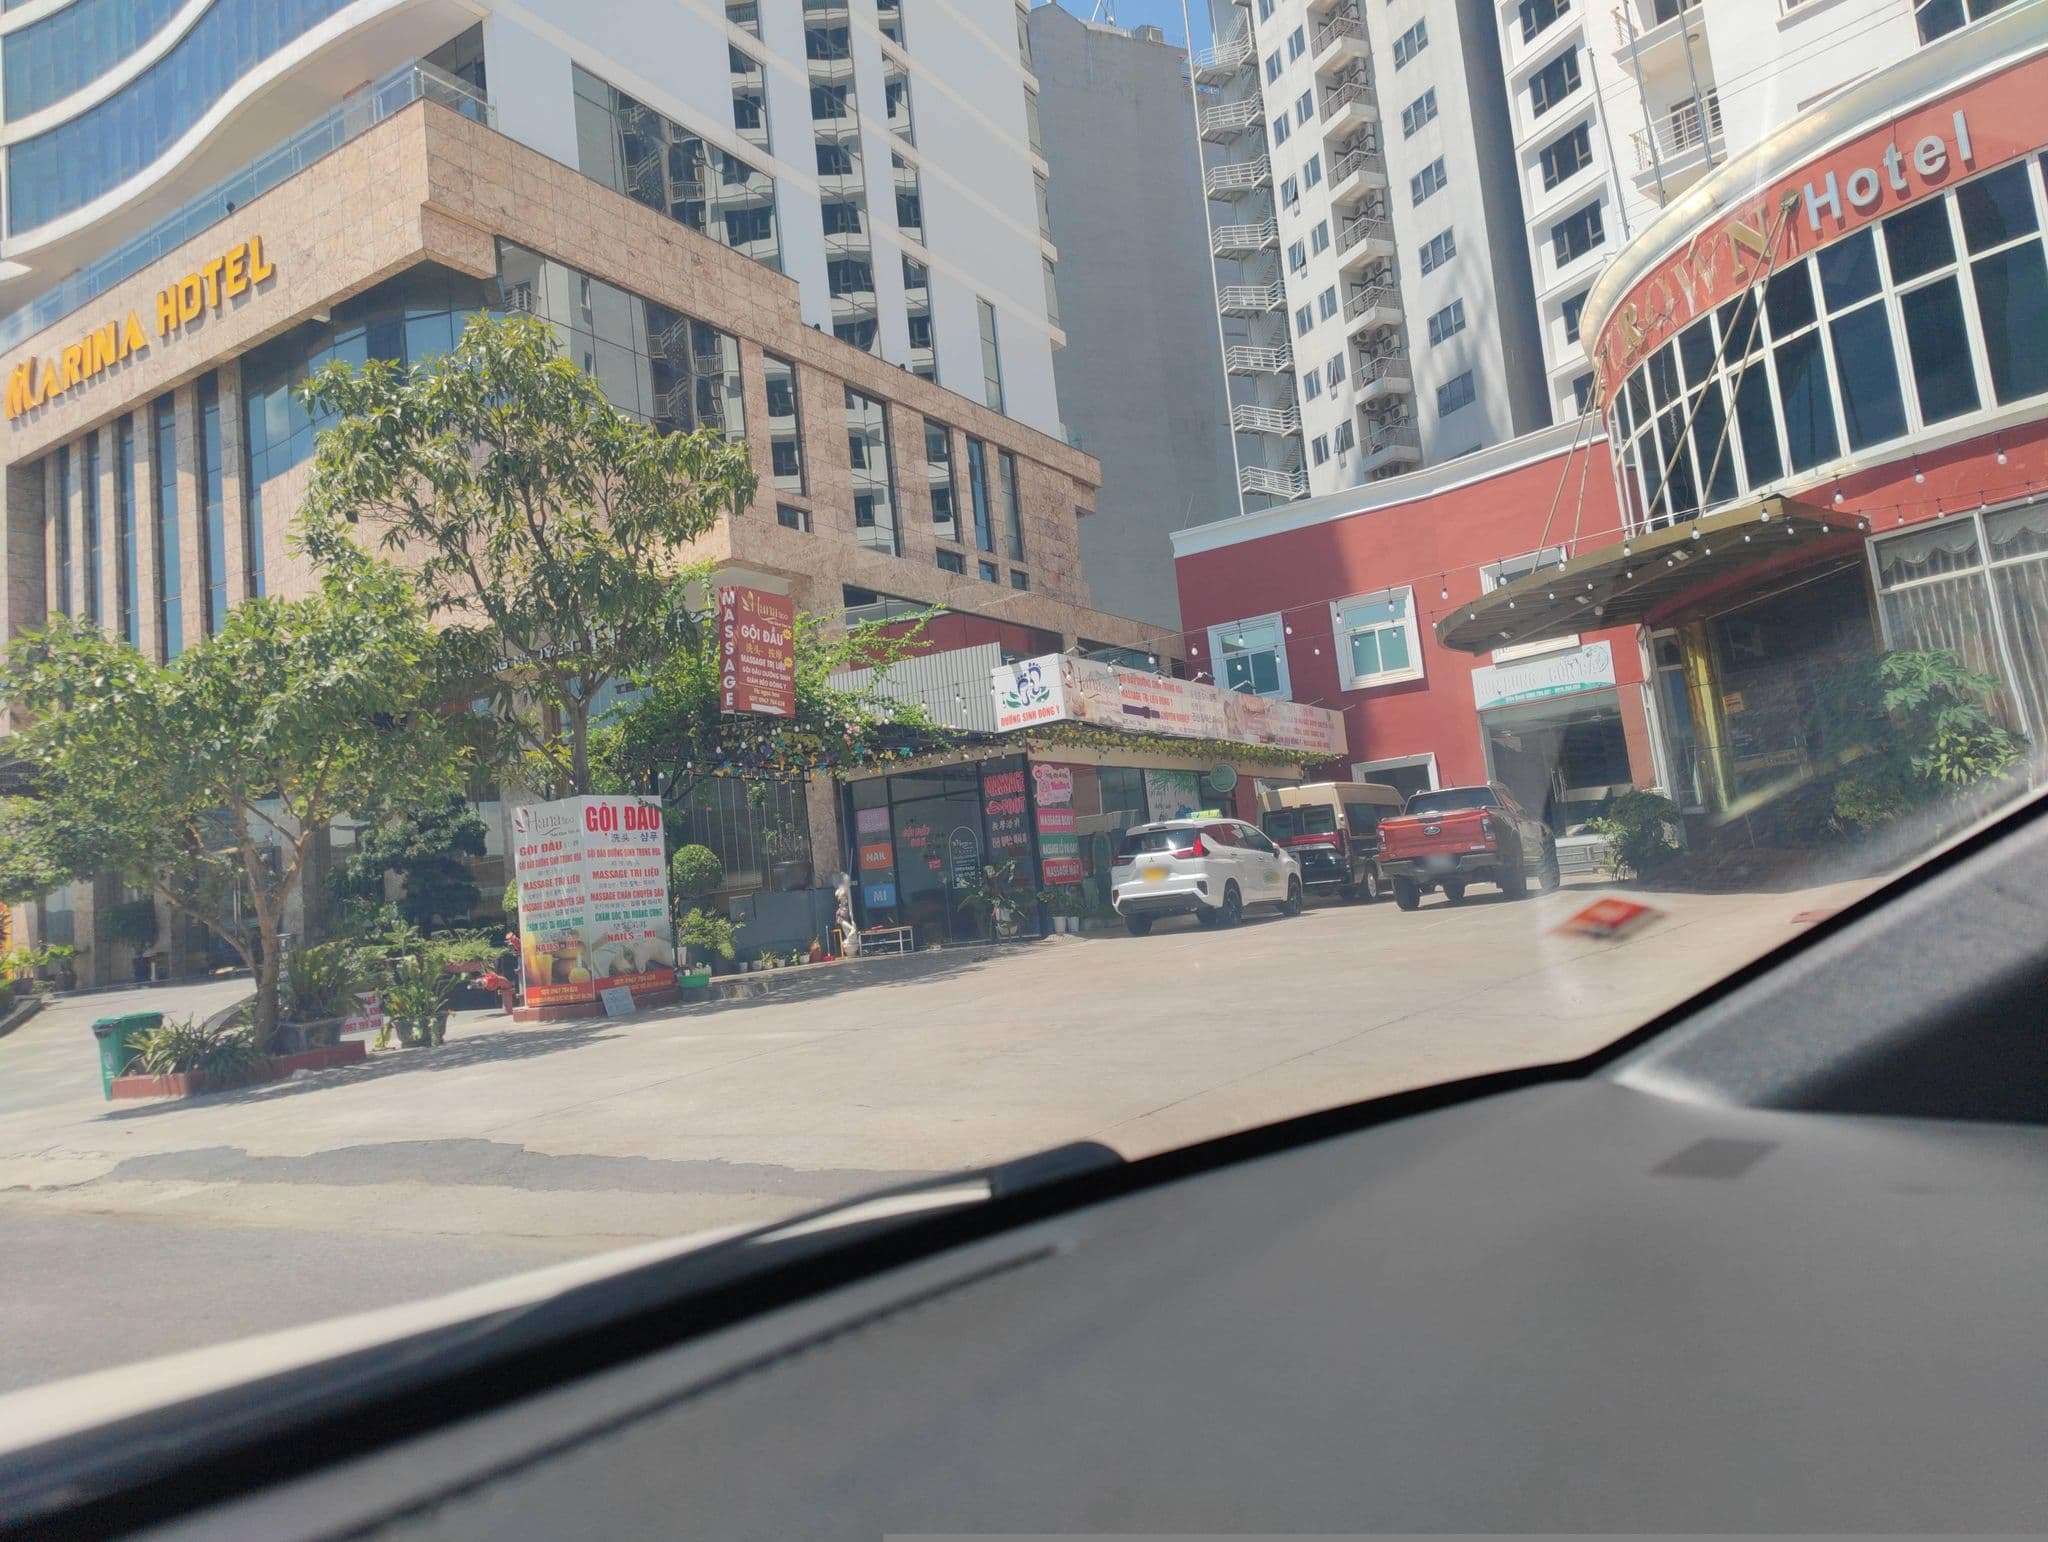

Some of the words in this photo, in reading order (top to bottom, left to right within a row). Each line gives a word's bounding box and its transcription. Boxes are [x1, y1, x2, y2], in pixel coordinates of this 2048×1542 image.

[1803, 109, 1972, 231] Hotel
[5, 308, 149, 421] MARINA
[156, 235, 275, 337] HOTEL
[741, 624, 760, 644] GỘI
[721, 591, 736, 706] MASSAGE
[740, 653, 766, 667] MASSAGE
[1022, 710, 1037, 722] SINH
[585, 801, 618, 837] GỘI
[866, 851, 887, 862] NAIL
[592, 869, 627, 880] MASSAGE
[523, 879, 553, 890] MASSAGE
[590, 891, 616, 901] MASSAGE
[873, 889, 888, 903] MI
[607, 931, 634, 942] NAILS
[644, 929, 656, 939] MI
